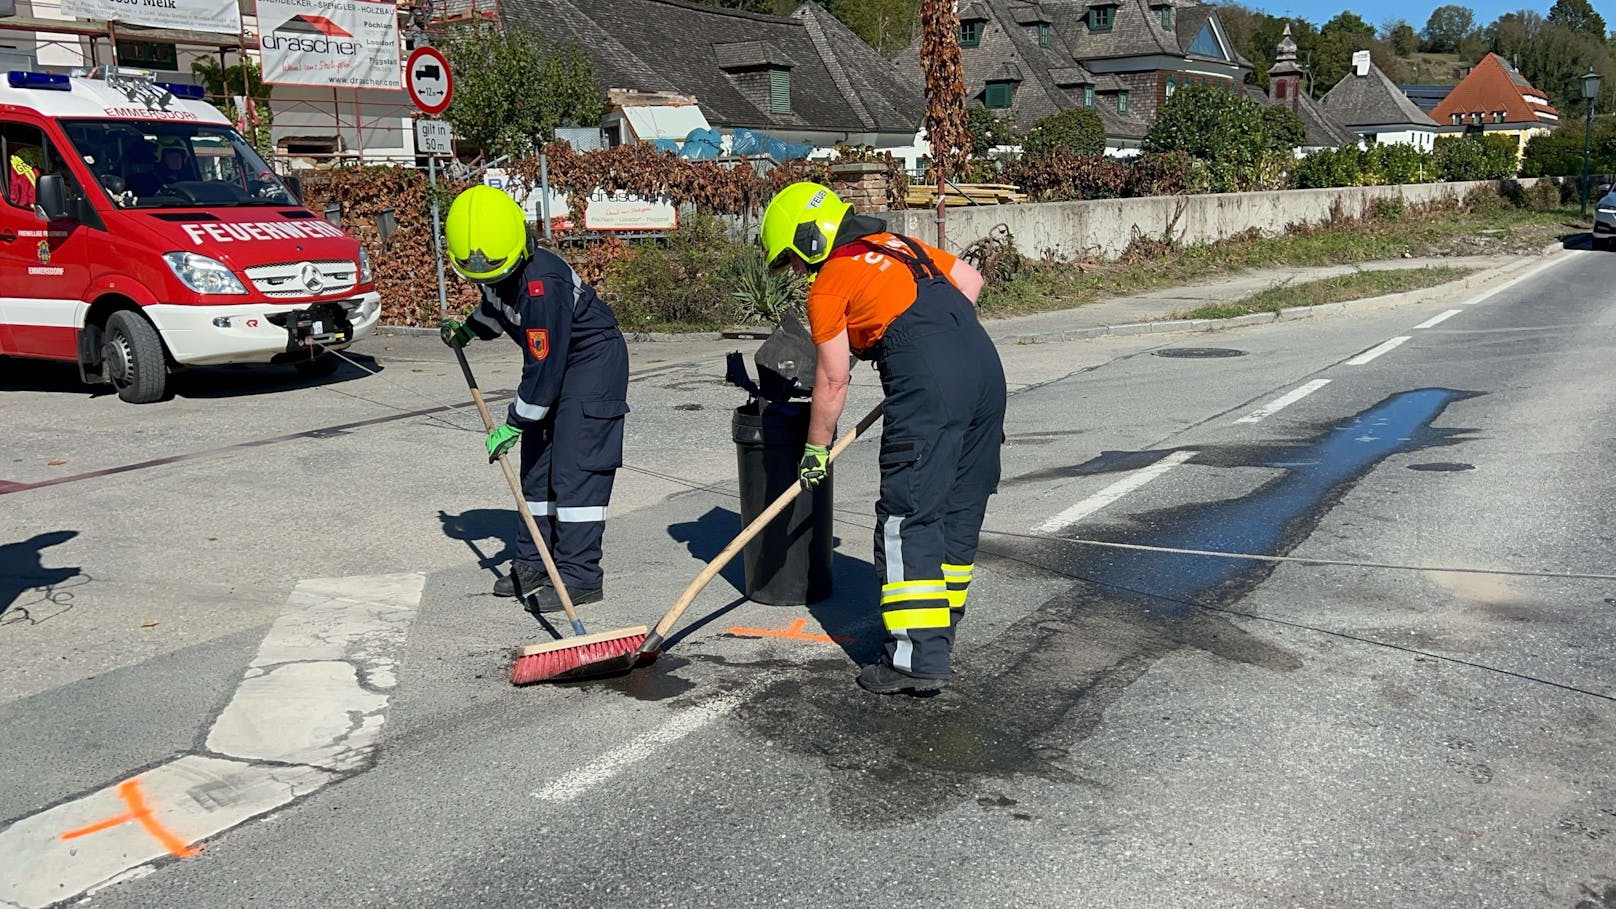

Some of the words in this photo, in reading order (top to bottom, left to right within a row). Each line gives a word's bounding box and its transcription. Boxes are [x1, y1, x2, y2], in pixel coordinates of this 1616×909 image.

[318, 2, 356, 11] SPENGLER
[361, 6, 395, 15] HOLZBAU
[262, 30, 363, 56] drascher
[422, 122, 436, 137] gilt
[437, 123, 446, 135] in
[181, 220, 345, 246] FEUERWEHR
